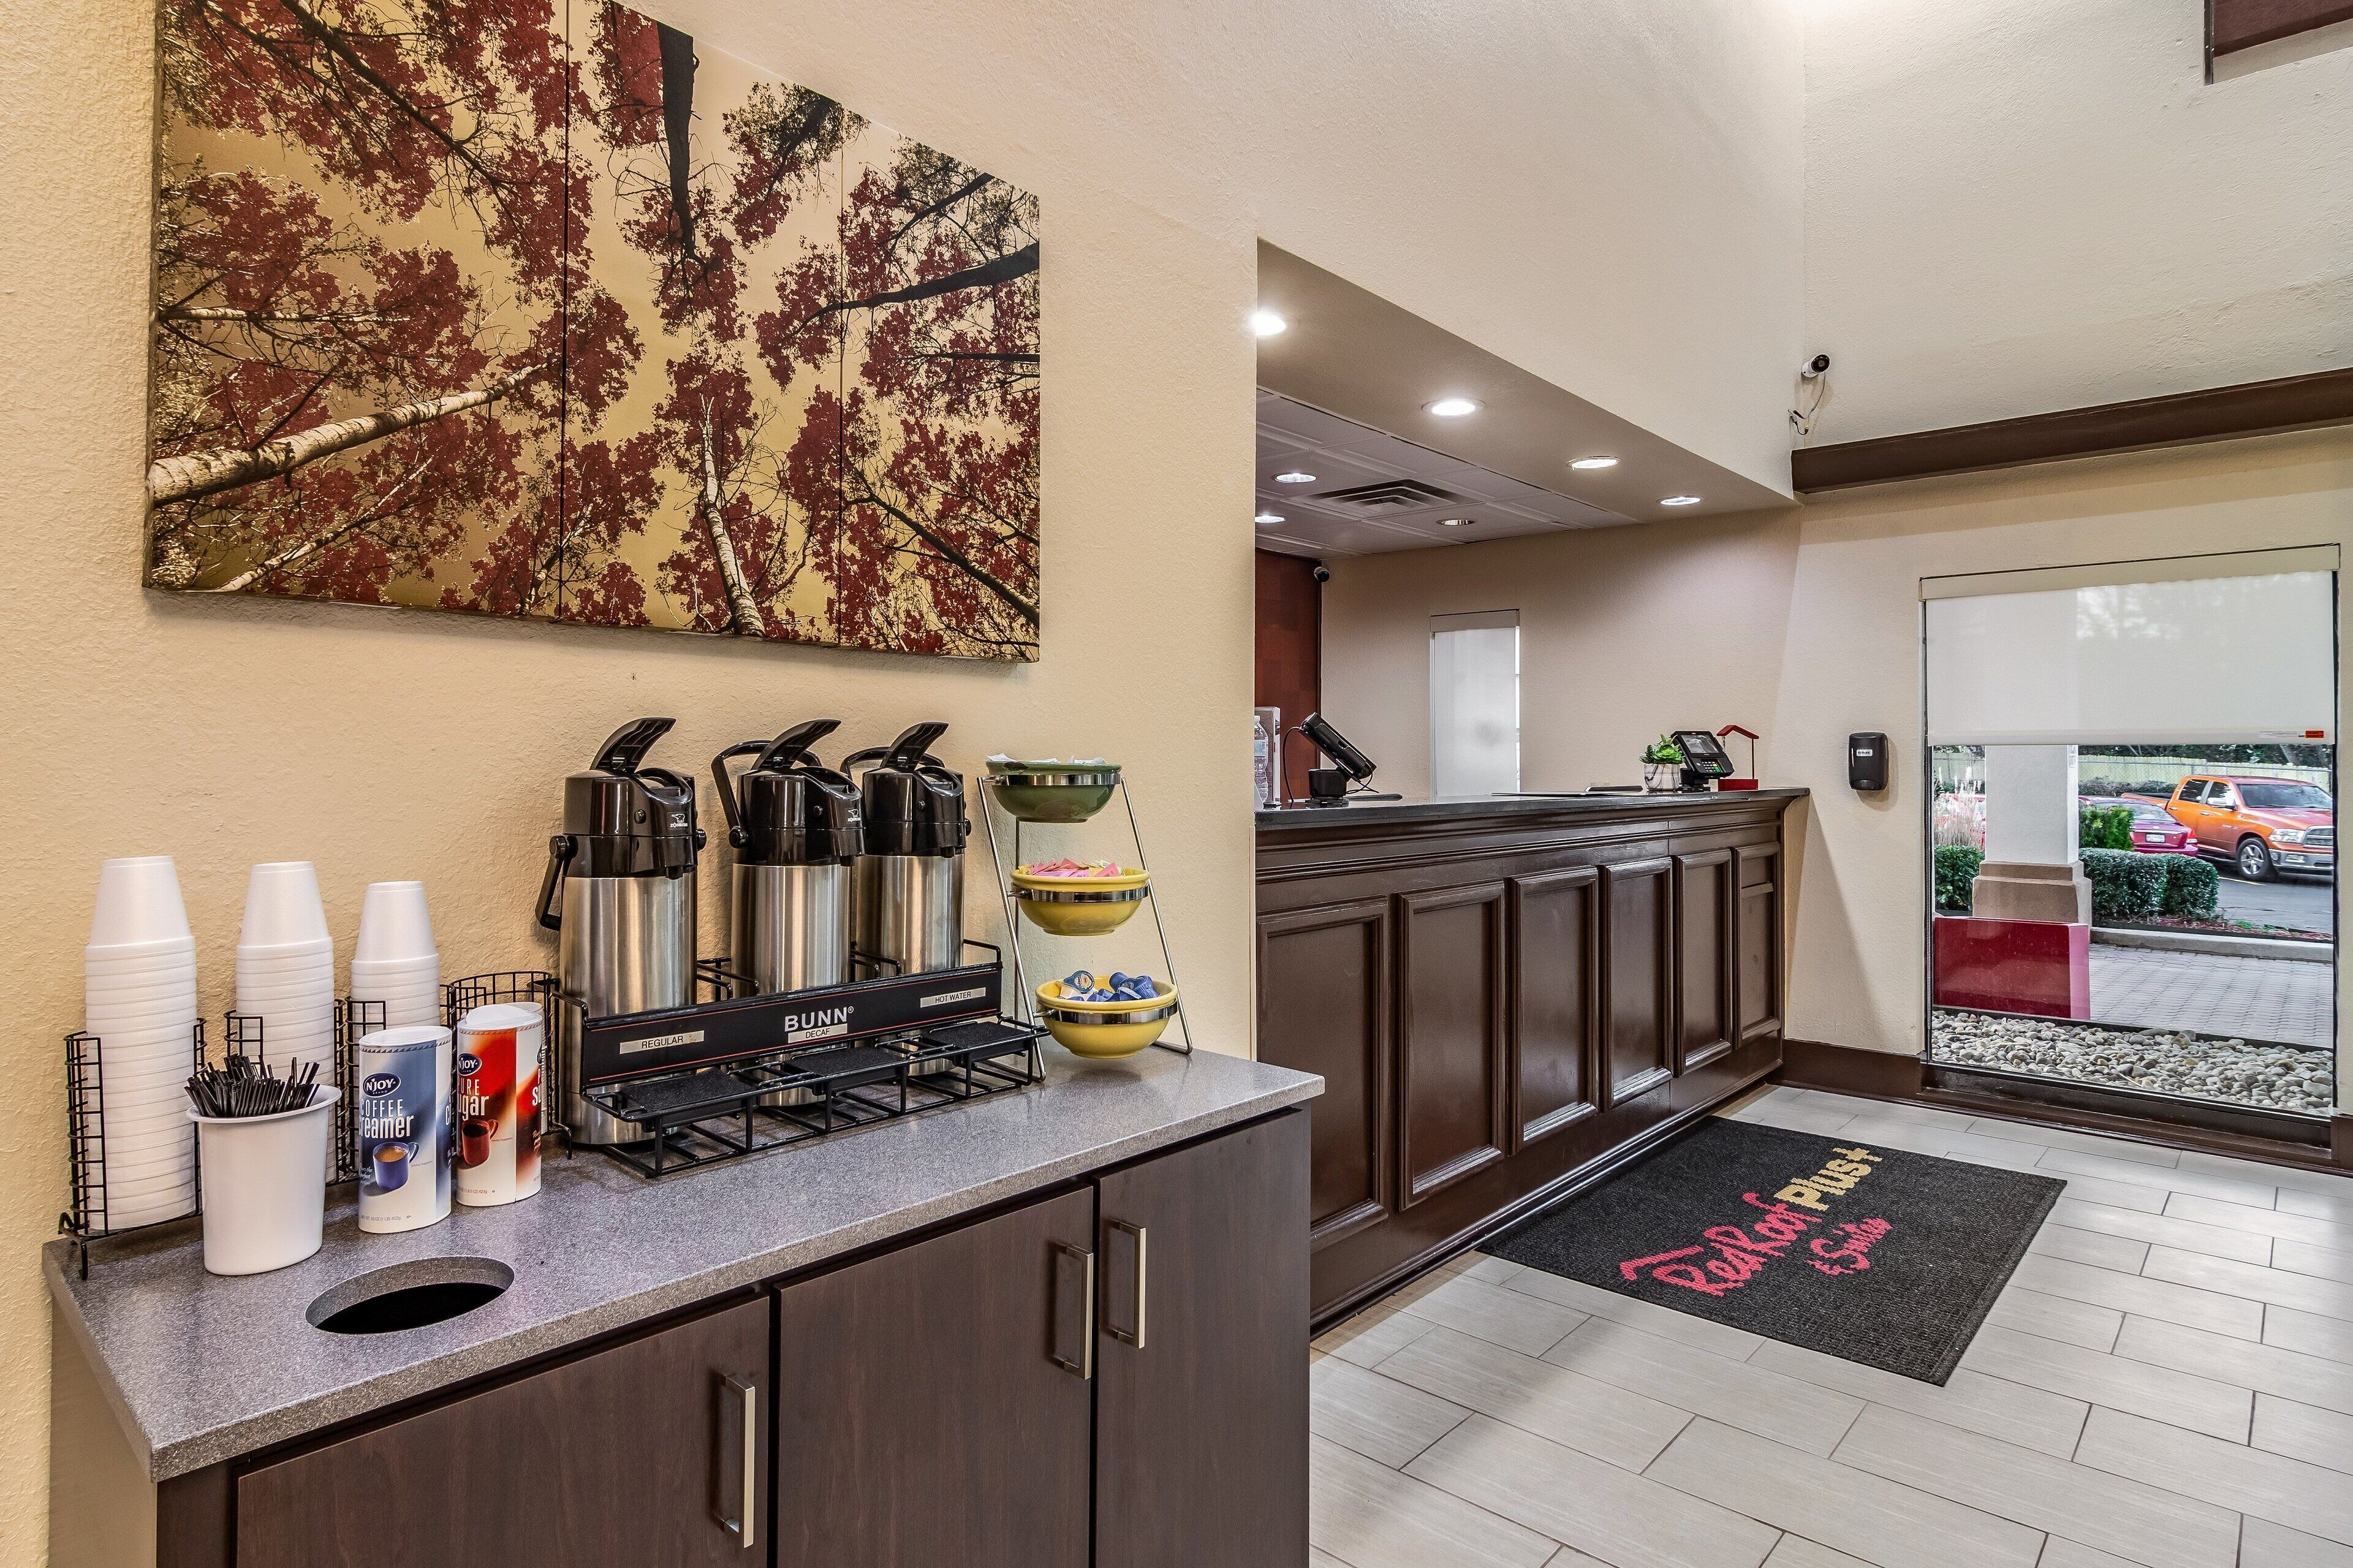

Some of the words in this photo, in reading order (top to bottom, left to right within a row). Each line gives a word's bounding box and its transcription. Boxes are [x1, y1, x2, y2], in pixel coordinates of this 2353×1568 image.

[935, 995, 949, 1004] HOT
[949, 991, 971, 1001] WATER
[806, 1028, 830, 1039] DECAF
[642, 1036, 683, 1049] REGULAR
[360, 1099, 403, 1117] COFFEE
[458, 1093, 490, 1121] ugar
[359, 1115, 414, 1138] reamer
